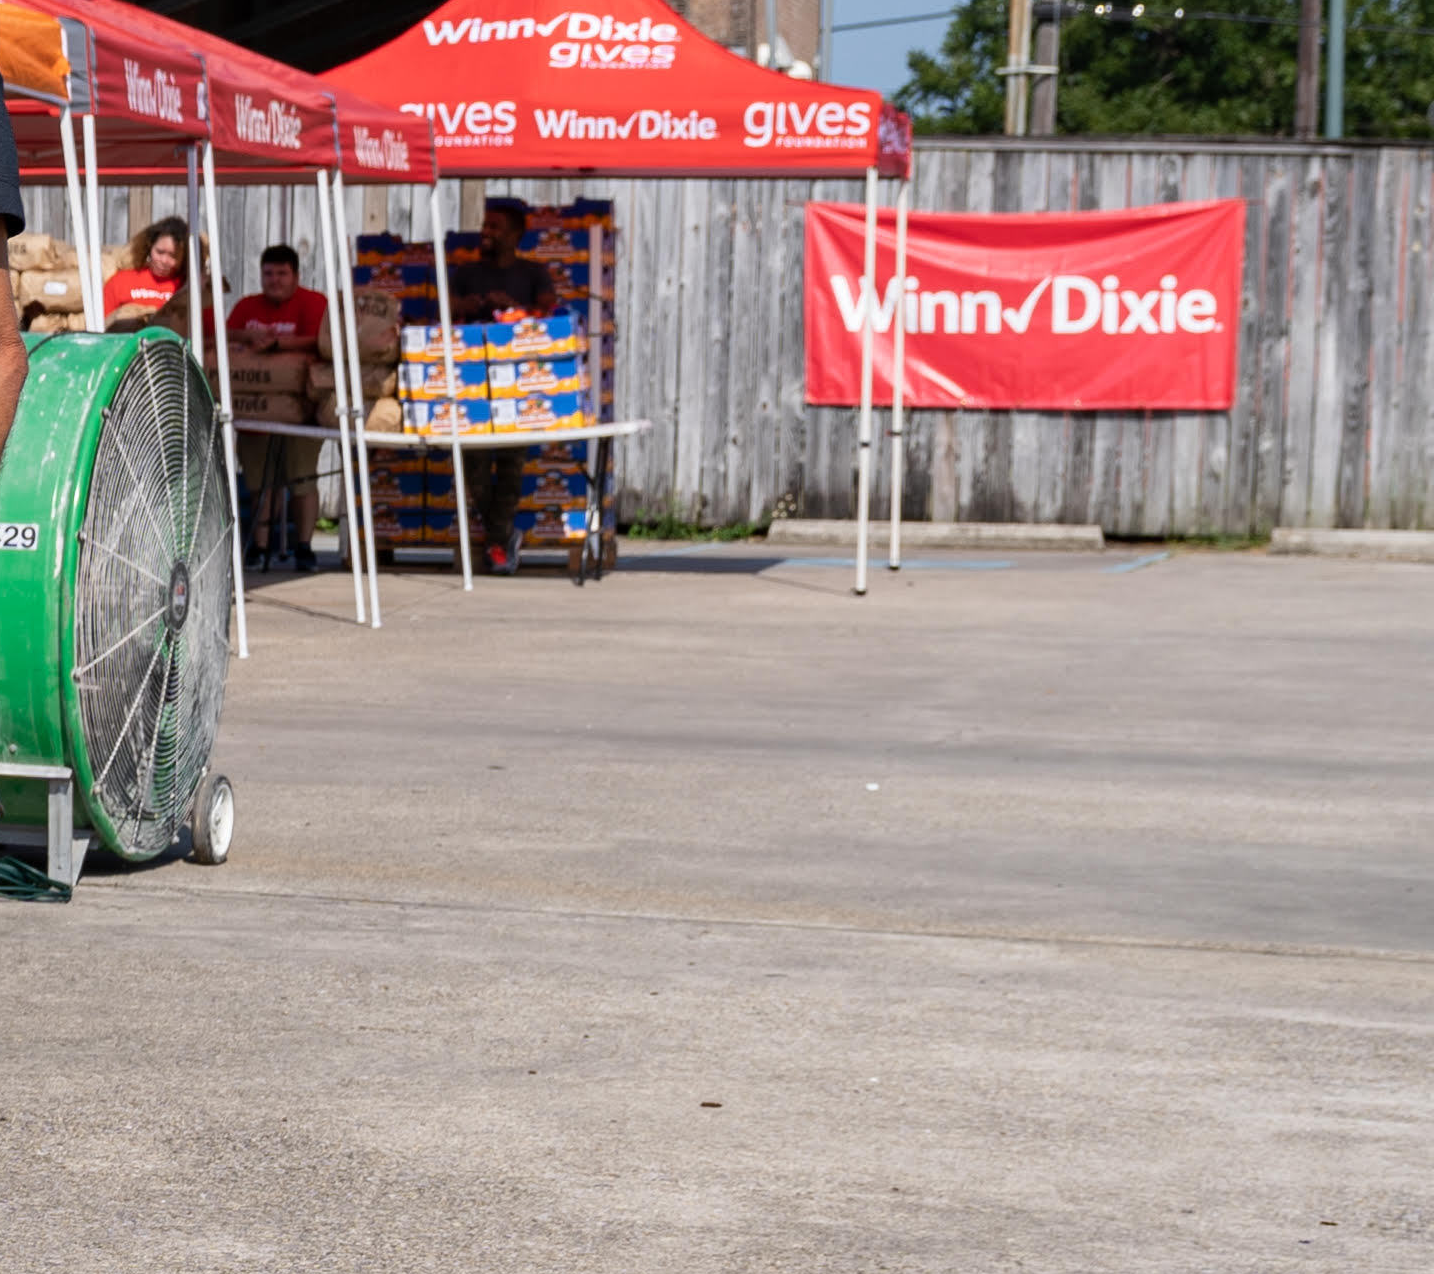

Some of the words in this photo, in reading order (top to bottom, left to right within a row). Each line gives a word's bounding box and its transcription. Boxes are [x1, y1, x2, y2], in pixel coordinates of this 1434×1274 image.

[423, 18, 535, 46] Winn
[567, 13, 678, 42] Dixie
[548, 42, 676, 68] gives
[533, 109, 617, 140] Winn
[638, 109, 718, 140] Dixie
[743, 101, 871, 148] gives
[434, 135, 514, 148] OUNDATION
[829, 275, 1002, 334] Winn
[1051, 275, 1219, 334] Dixie
